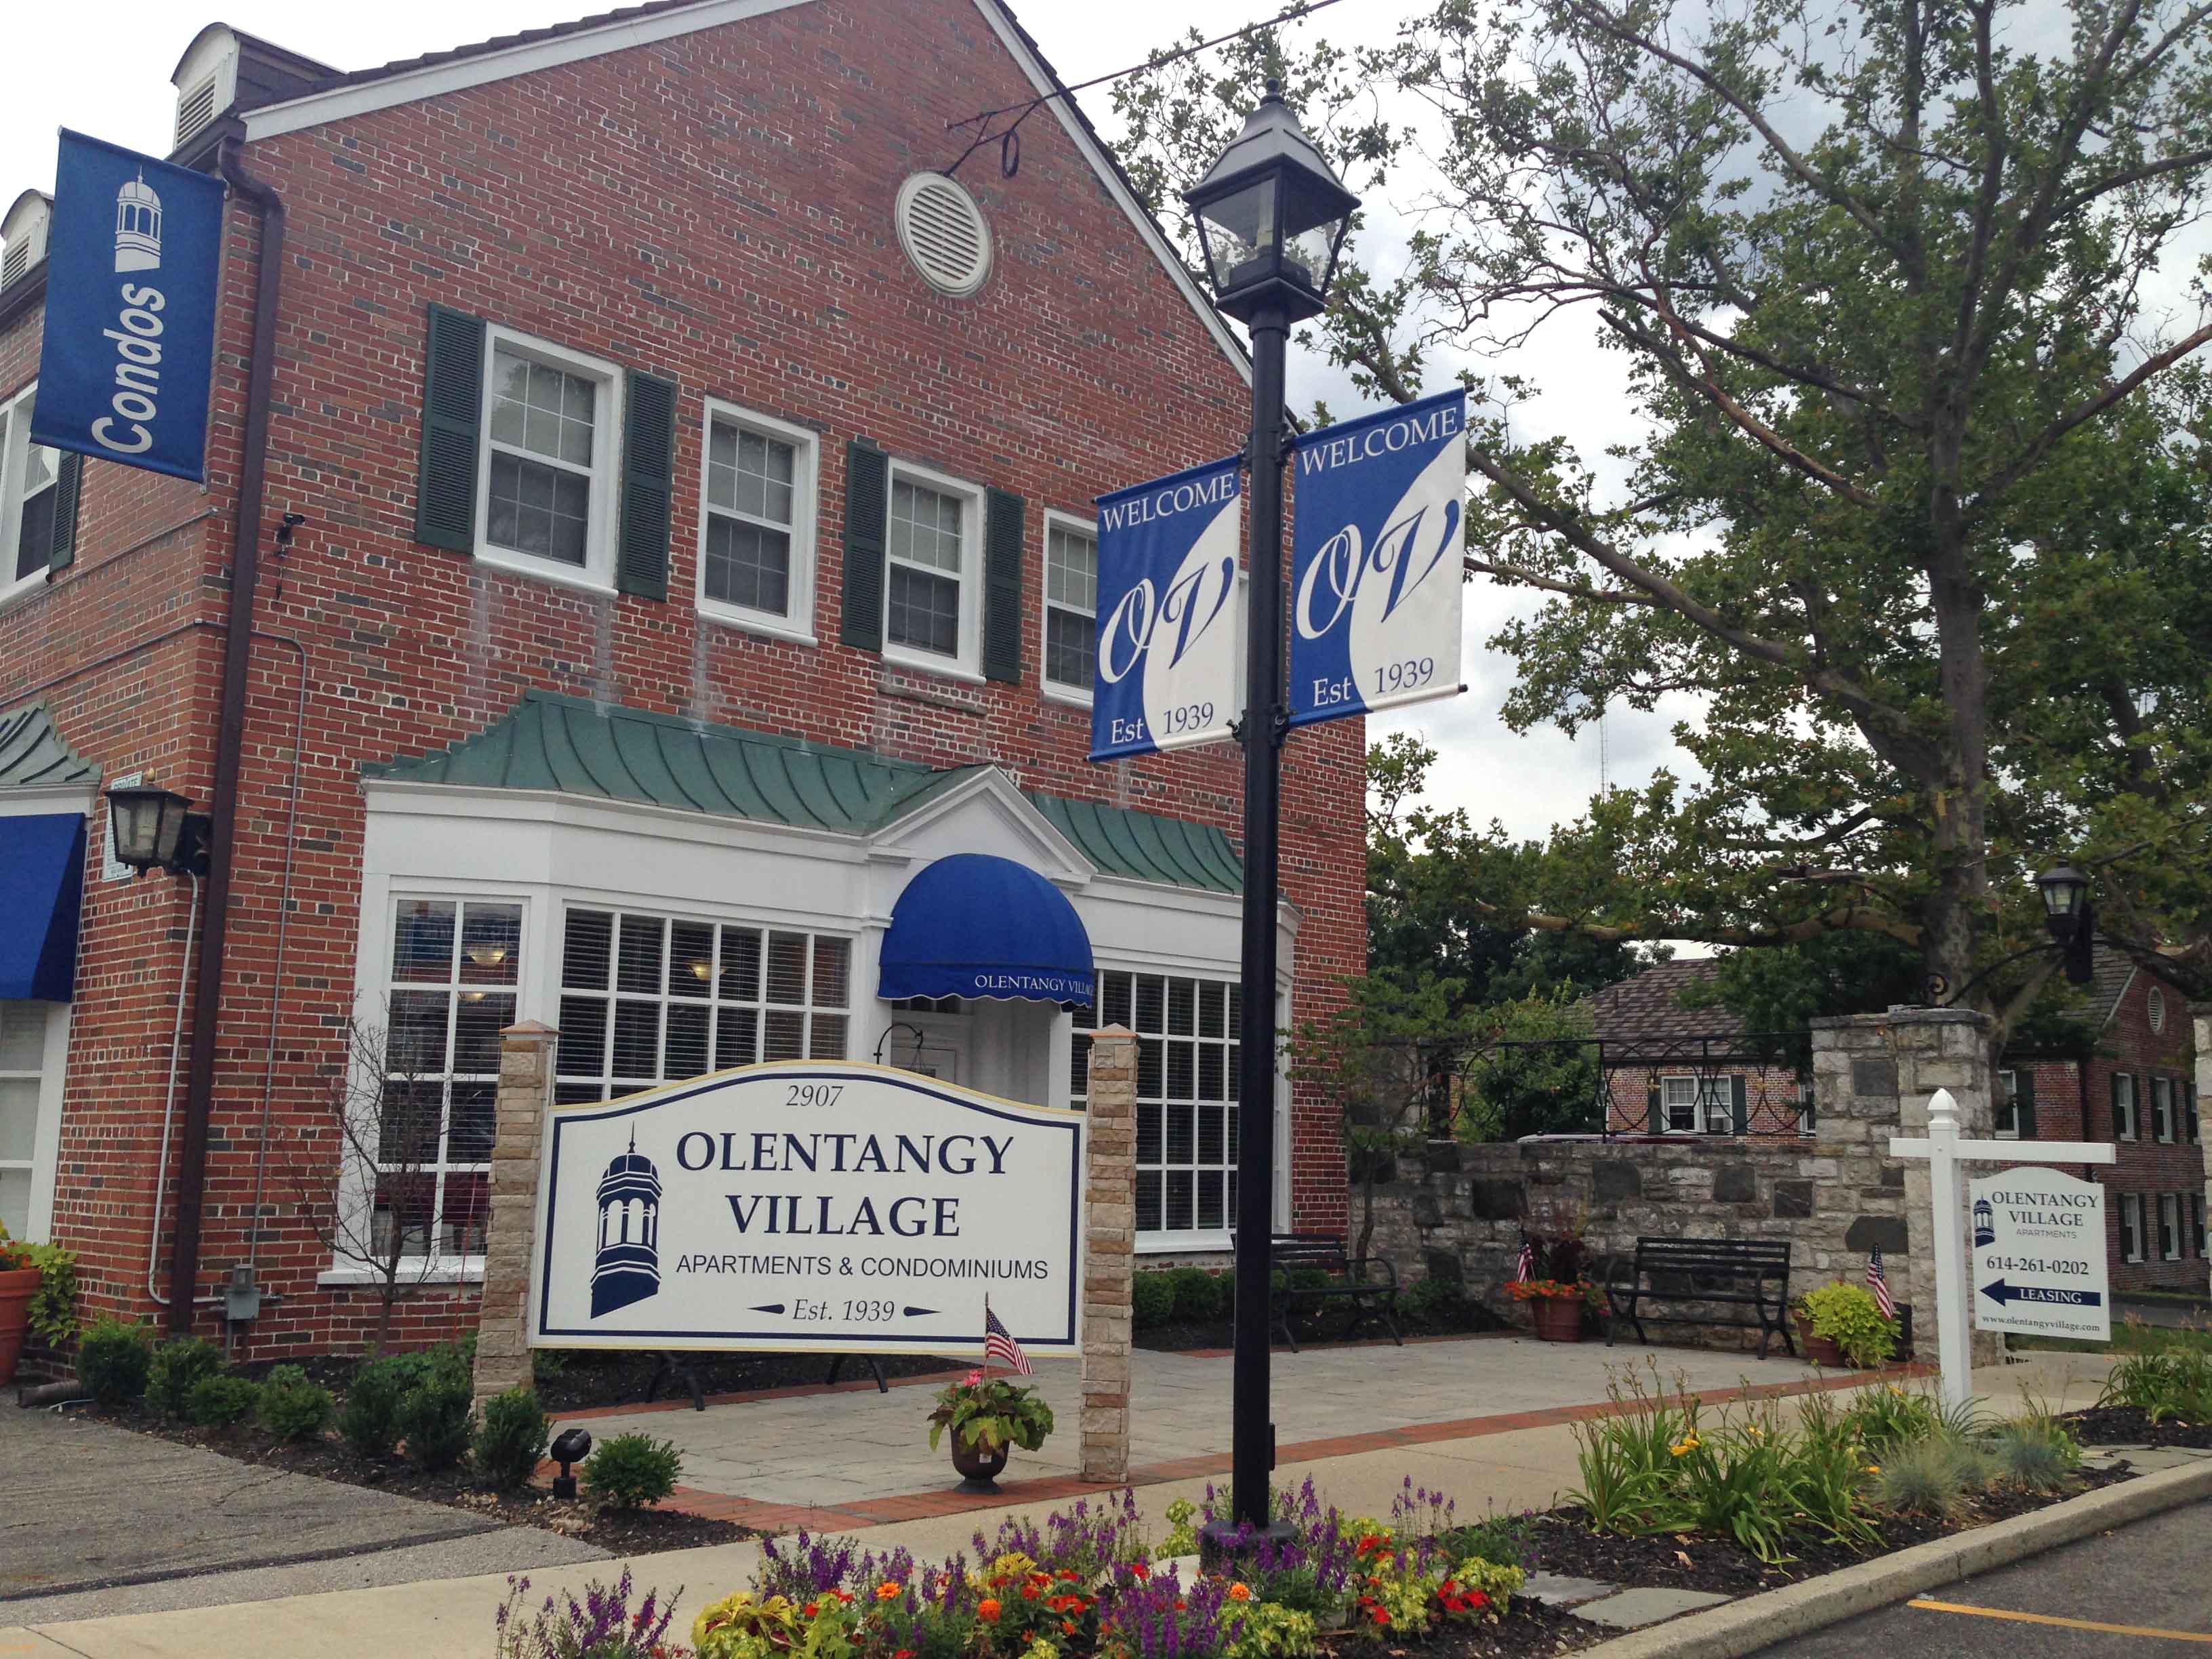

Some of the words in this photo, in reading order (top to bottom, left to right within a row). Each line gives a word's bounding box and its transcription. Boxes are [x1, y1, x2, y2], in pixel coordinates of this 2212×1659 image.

[91, 283, 165, 453] Condos
[1302, 406, 1458, 476] WELCOME
[1103, 472, 1235, 533] WELCOME
[1296, 499, 1460, 640] OV
[1099, 556, 1234, 684] OV
[1312, 676, 1352, 708] Est
[1374, 657, 1435, 695] 1939
[1110, 718, 1144, 745] Est
[1162, 702, 1214, 735] 1939
[975, 975, 1065, 992] OLENTANGY
[785, 1084, 844, 1107] 2907
[676, 1132, 1015, 1175] OLENTANGY
[1992, 1191, 2098, 1208] OLENTANGY
[724, 1194, 961, 1237] VILLAGE
[2008, 1210, 2084, 1227] VILLAGE
[2016, 1228, 2077, 1240] APARTMENTS
[676, 1255, 832, 1277] APARTMENTS
[839, 1257, 854, 1277] &
[861, 1257, 1049, 1280] CONDOMINIUMS
[1986, 1255, 2089, 1275] 614-261-0202
[2020, 1288, 2083, 1304] LEASING
[793, 1298, 834, 1322] Est.
[844, 1299, 896, 1323] 1939
[1982, 1314, 2100, 1332] www.olentangyvillage.com
